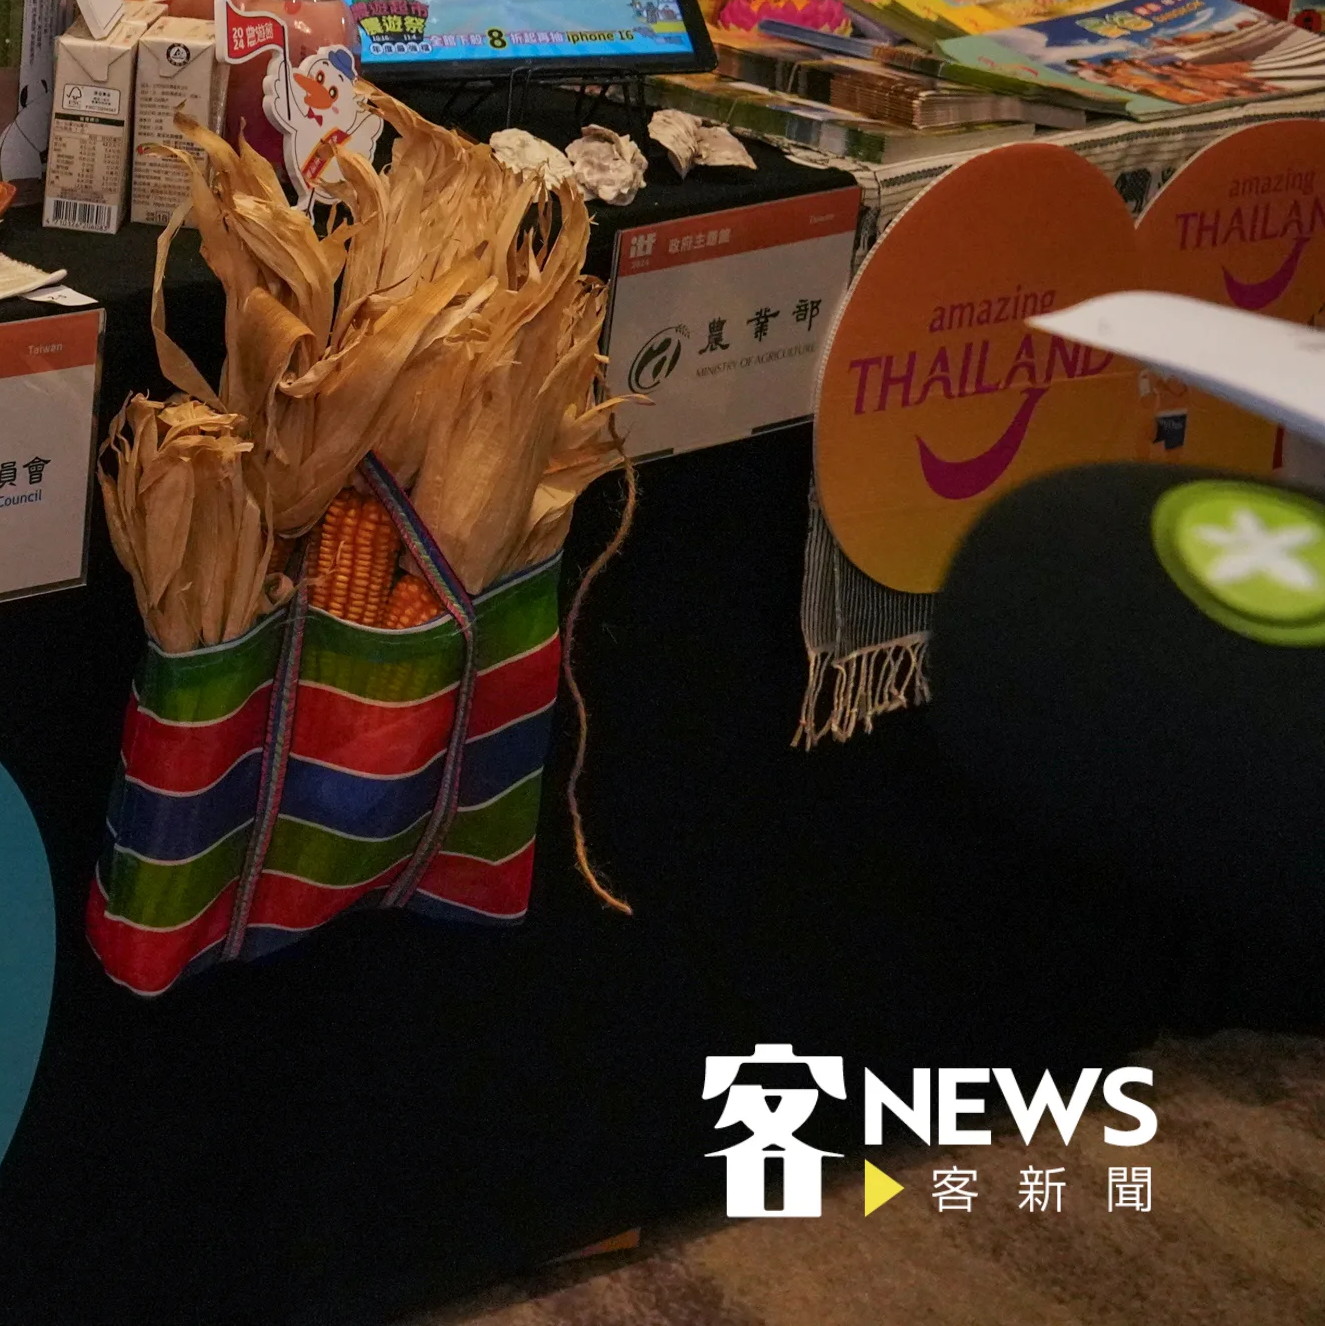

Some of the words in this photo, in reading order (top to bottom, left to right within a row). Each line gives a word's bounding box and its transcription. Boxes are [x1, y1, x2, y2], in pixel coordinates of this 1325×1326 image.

[1229, 167, 1316, 198] amazing
[698, 297, 823, 356] 農業部
[928, 286, 1056, 333] amazing
[27, 341, 64, 355] Taiwan
[850, 334, 1113, 416] THAILAND
